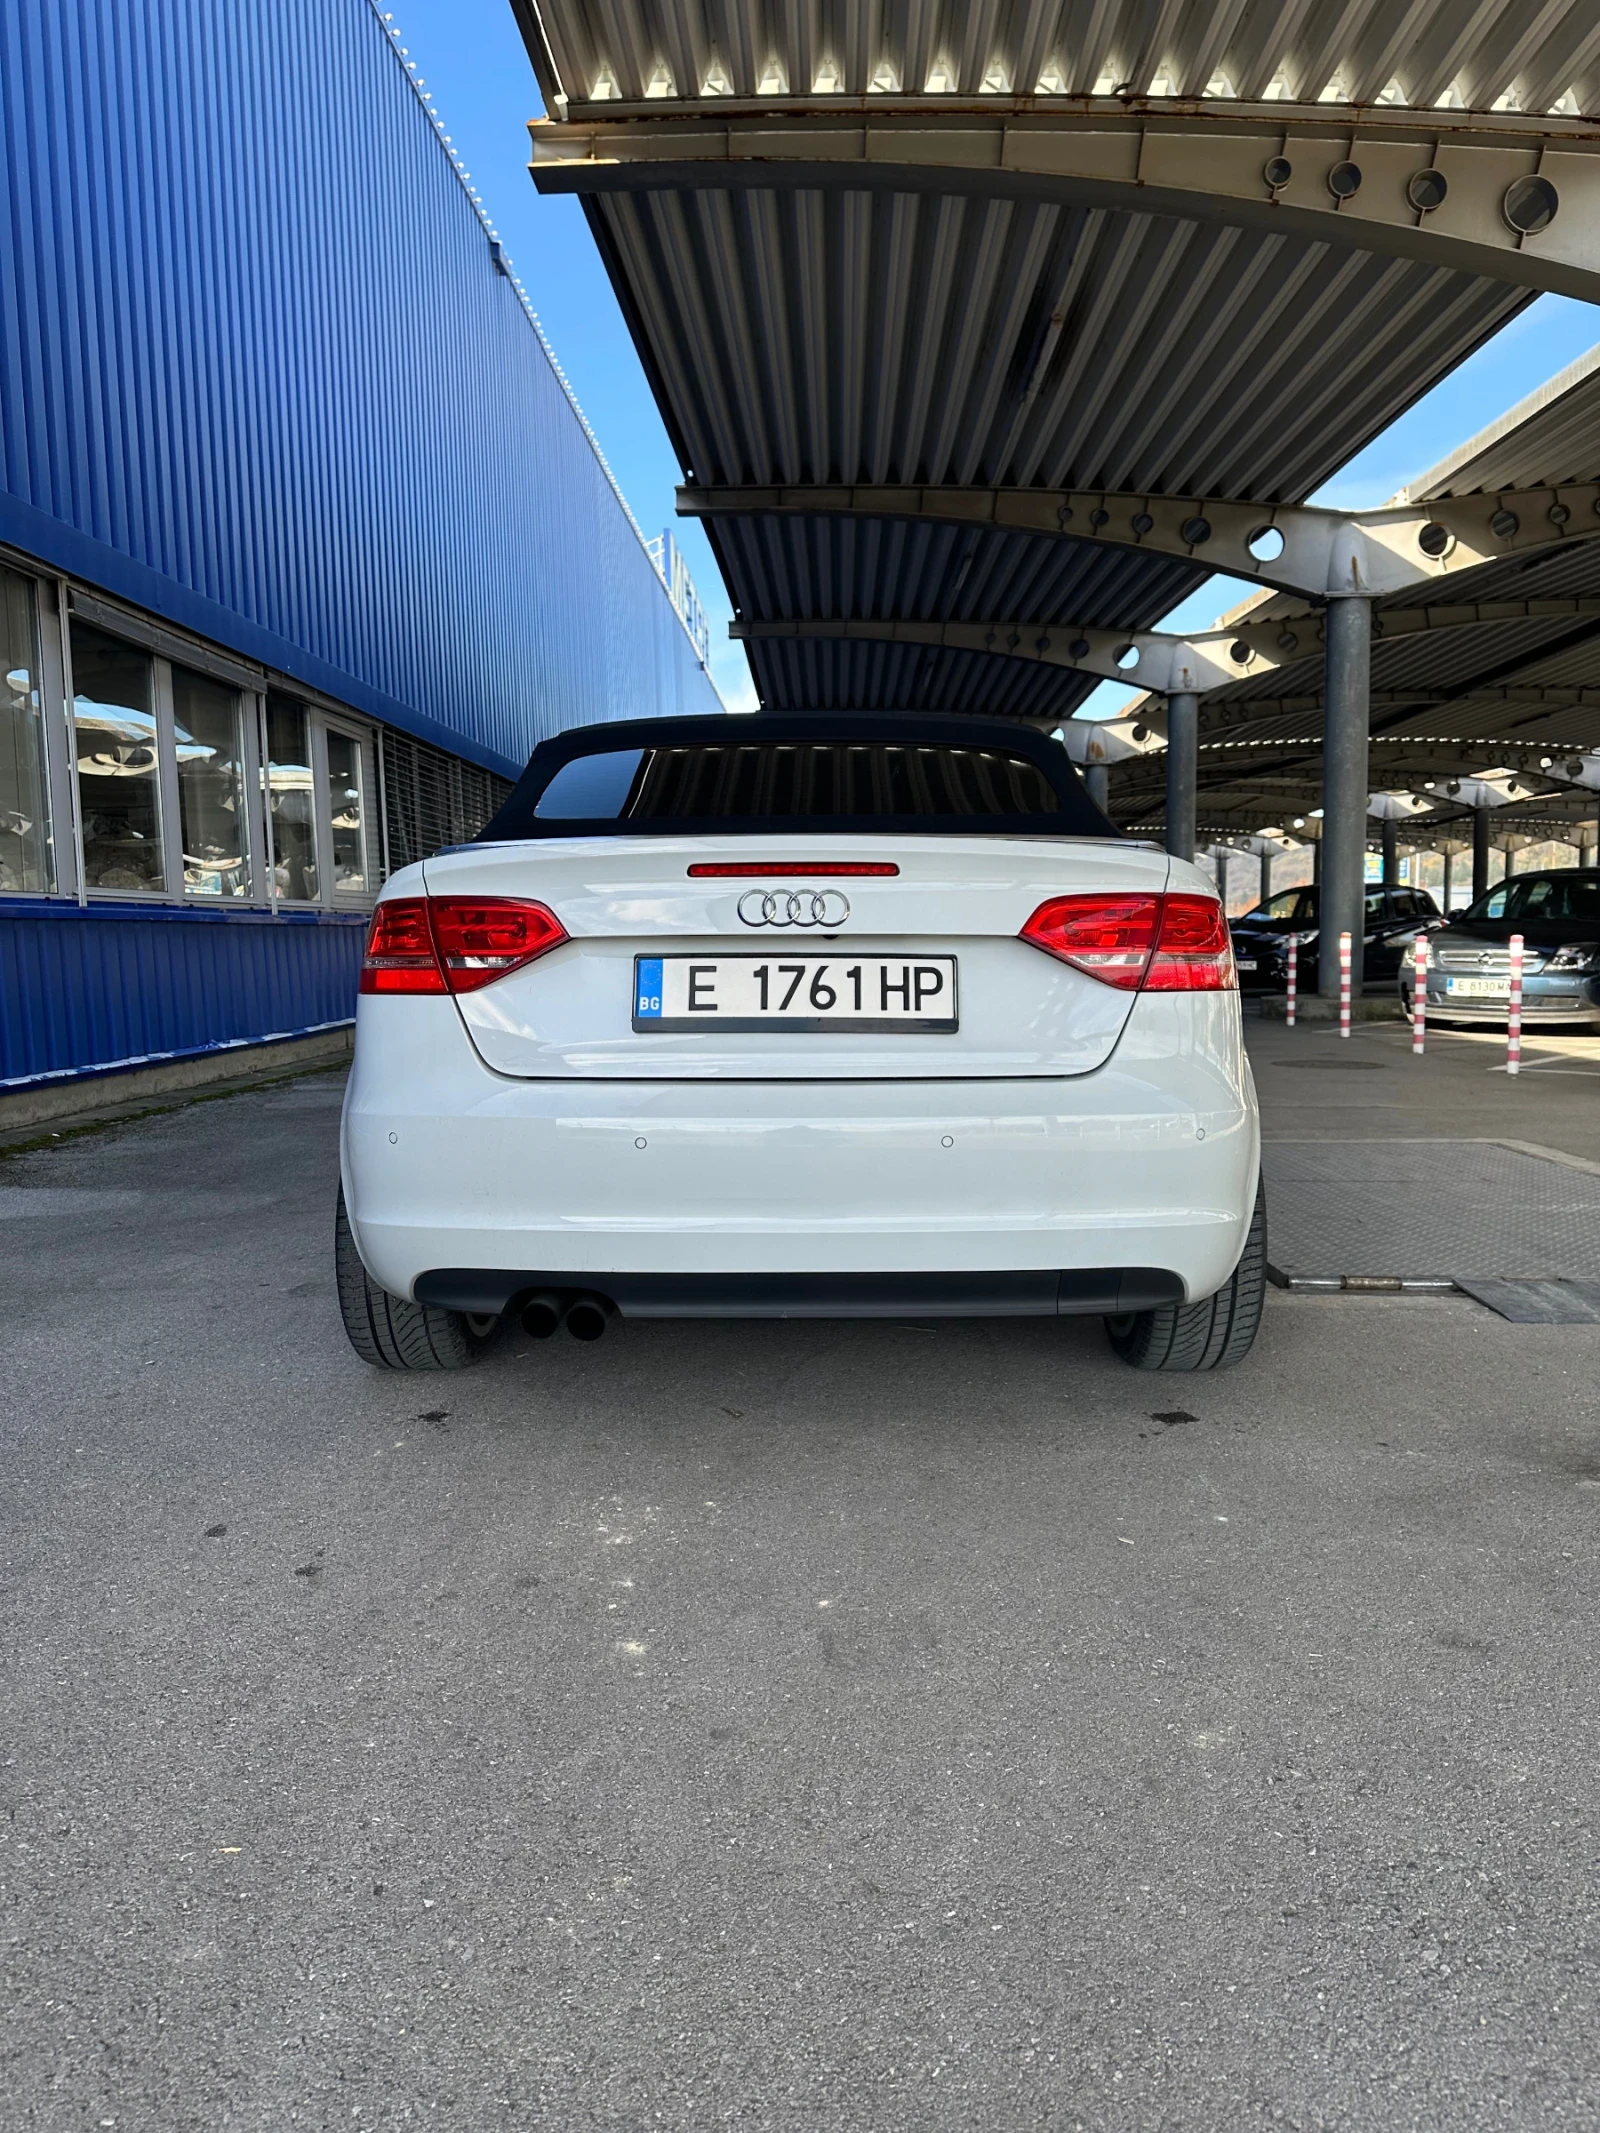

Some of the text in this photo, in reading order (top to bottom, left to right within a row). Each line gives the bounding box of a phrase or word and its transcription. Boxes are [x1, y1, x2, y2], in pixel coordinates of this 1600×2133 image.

[688, 965, 718, 1011] E
[1458, 980, 1465, 991] E
[639, 996, 660, 1011] BG
